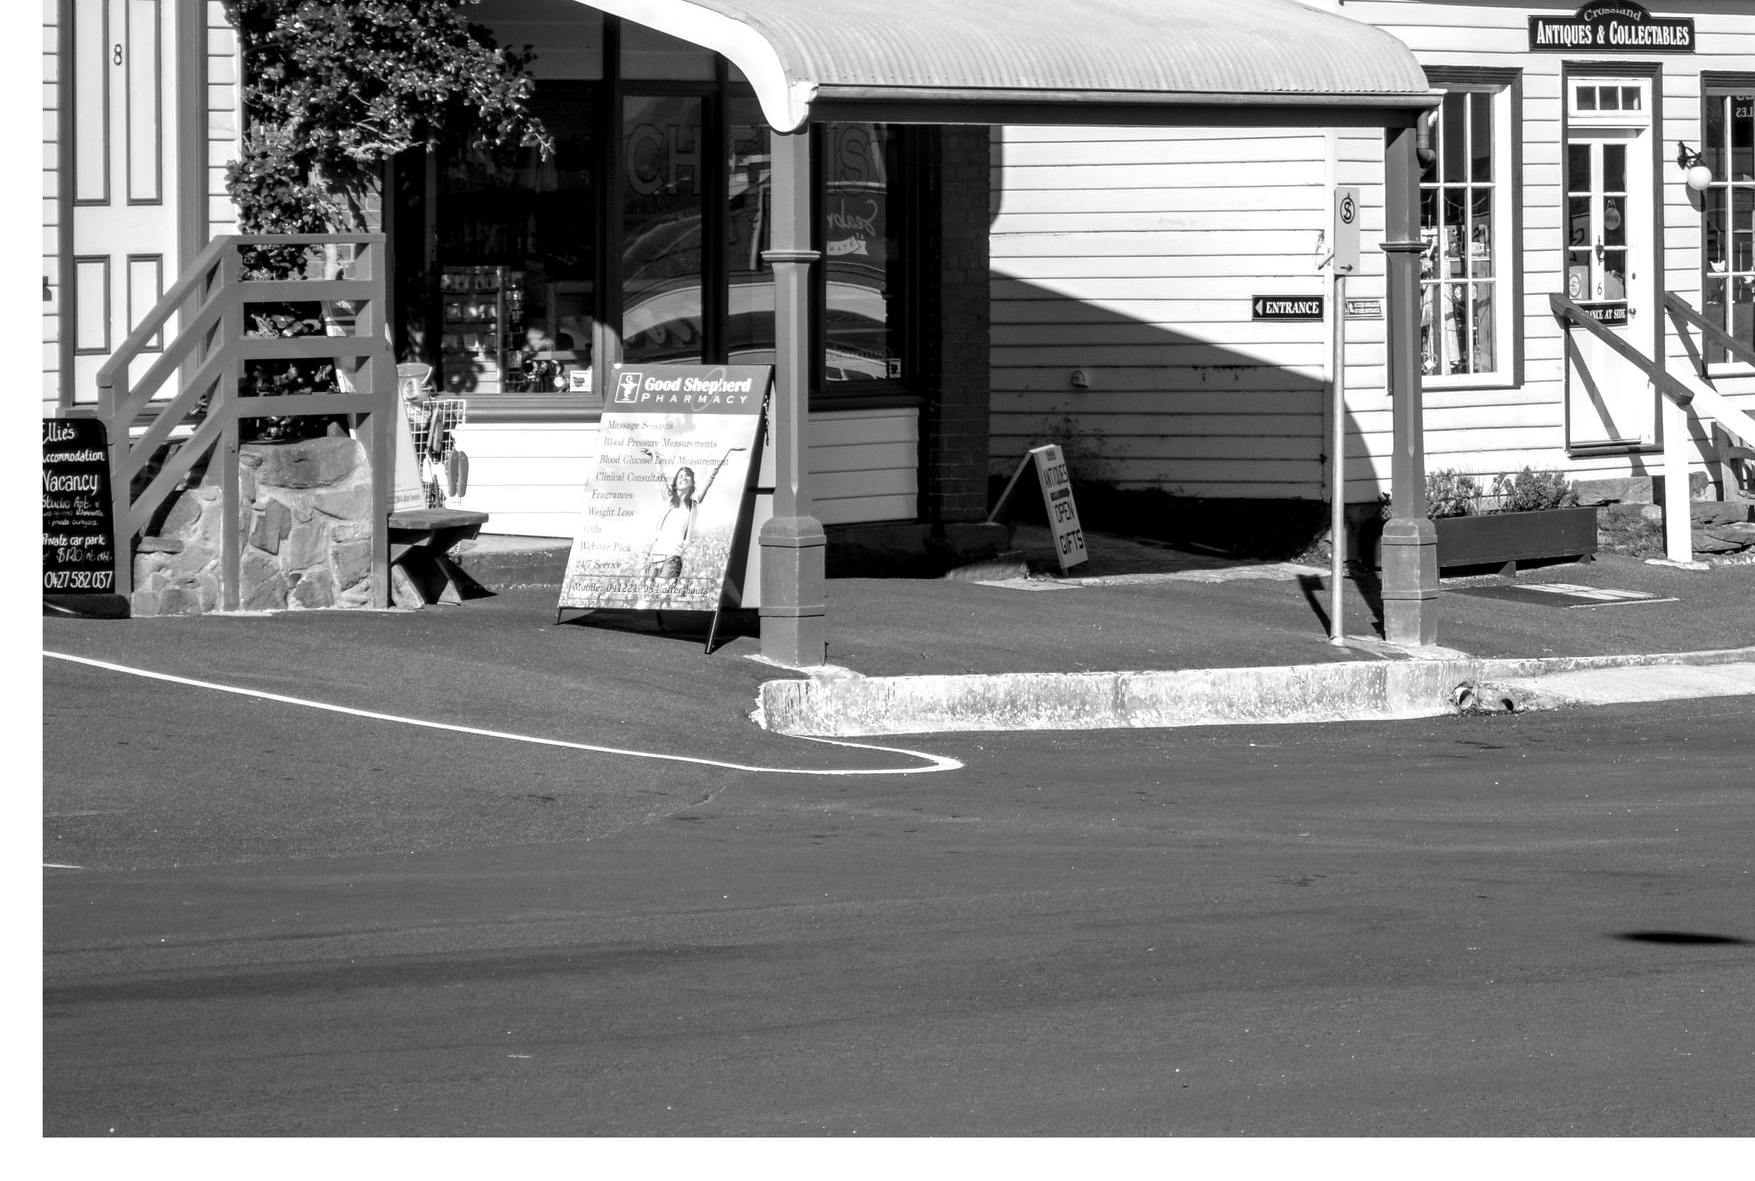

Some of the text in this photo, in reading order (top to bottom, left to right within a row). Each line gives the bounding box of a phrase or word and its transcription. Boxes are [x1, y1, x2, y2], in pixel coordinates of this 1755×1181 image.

[1584, 8, 1642, 22] Crossland
[1536, 20, 1690, 47] ANTIQUES & COLLECTABLES
[113, 43, 123, 66] 8
[1596, 281, 1603, 296] 6
[1265, 301, 1320, 315] ENTRANCE
[1605, 309, 1612, 319] AT
[1613, 308, 1626, 319] SIDE
[644, 377, 753, 395] Good Shepherd
[641, 393, 748, 405] PHARMACY
[607, 420, 641, 432] Massage
[603, 437, 718, 448] Blood Pressure Measurements
[600, 454, 729, 466] Blood Glucose Level Measurement
[43, 469, 98, 497] Vacancy
[595, 472, 625, 482] Clinical
[591, 489, 633, 501] Fragrances
[588, 506, 635, 519] Weight Loss
[1055, 500, 1075, 523] OPEN
[70, 536, 84, 546] car
[84, 534, 106, 549] park
[1059, 529, 1084, 555] GIFTS
[575, 559, 622, 570] 24/7 Service
[44, 570, 113, 589] 0427 582 037
